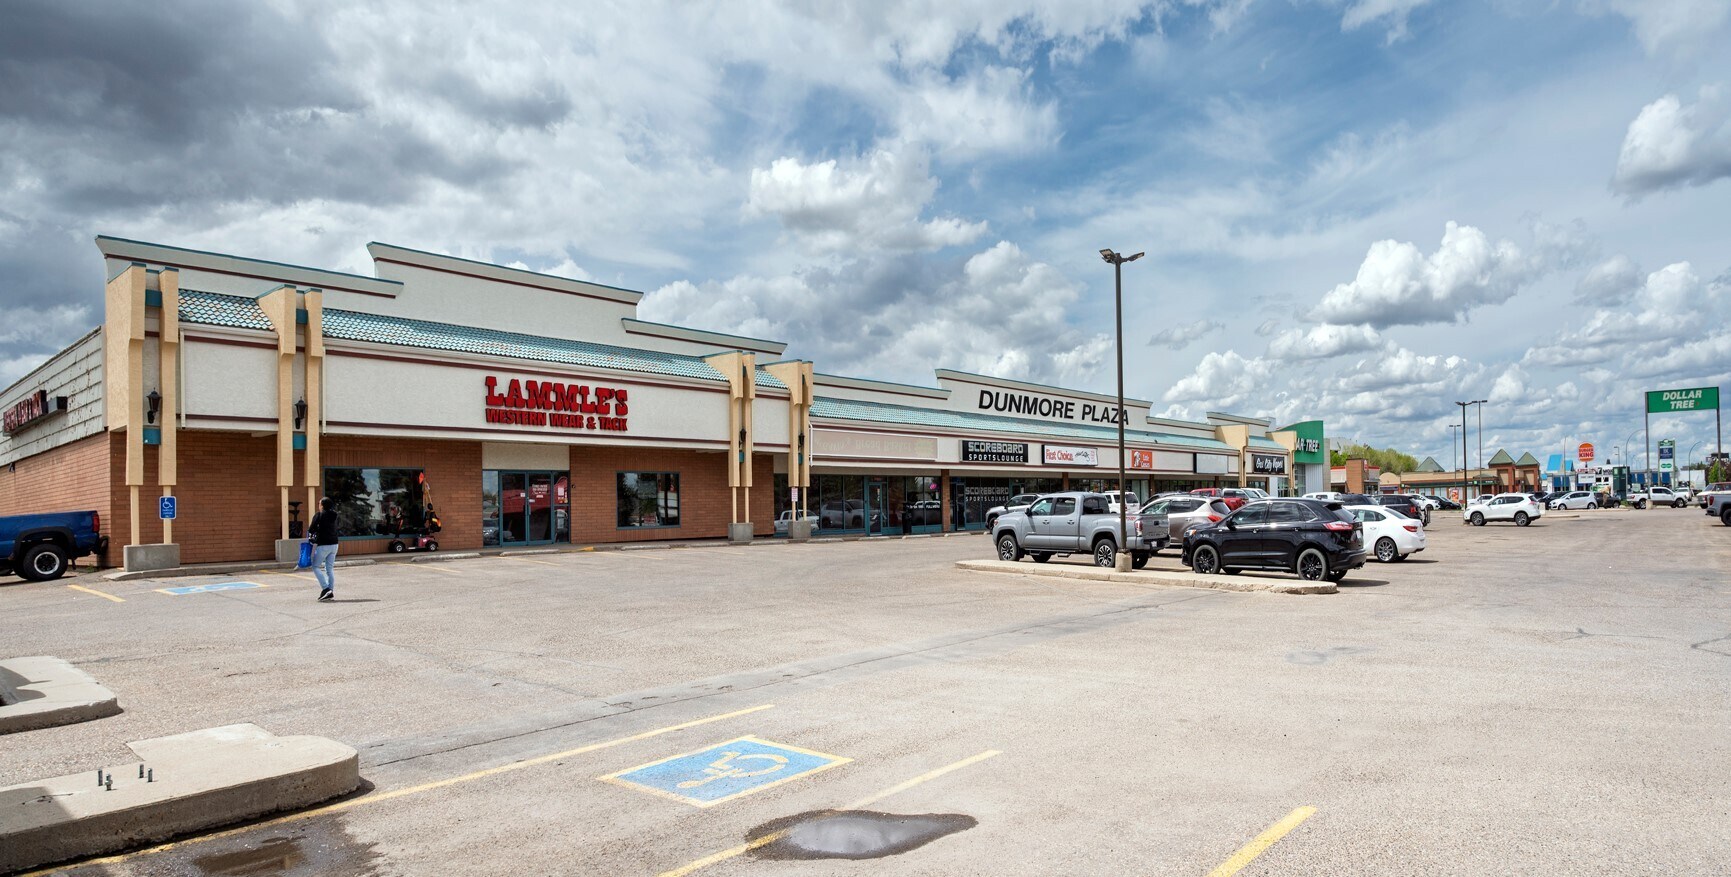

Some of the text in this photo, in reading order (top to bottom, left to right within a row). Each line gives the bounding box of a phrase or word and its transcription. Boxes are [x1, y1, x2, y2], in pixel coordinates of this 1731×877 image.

[485, 376, 628, 415] LAMMLE'S
[1662, 390, 1702, 400] DOLLAR
[979, 389, 1129, 425] DUNMORE PLAZA
[1670, 400, 1694, 409] TREE
[485, 408, 628, 432] WESTERN WEAR & TACK
[968, 441, 1024, 454] SCOREBOARD
